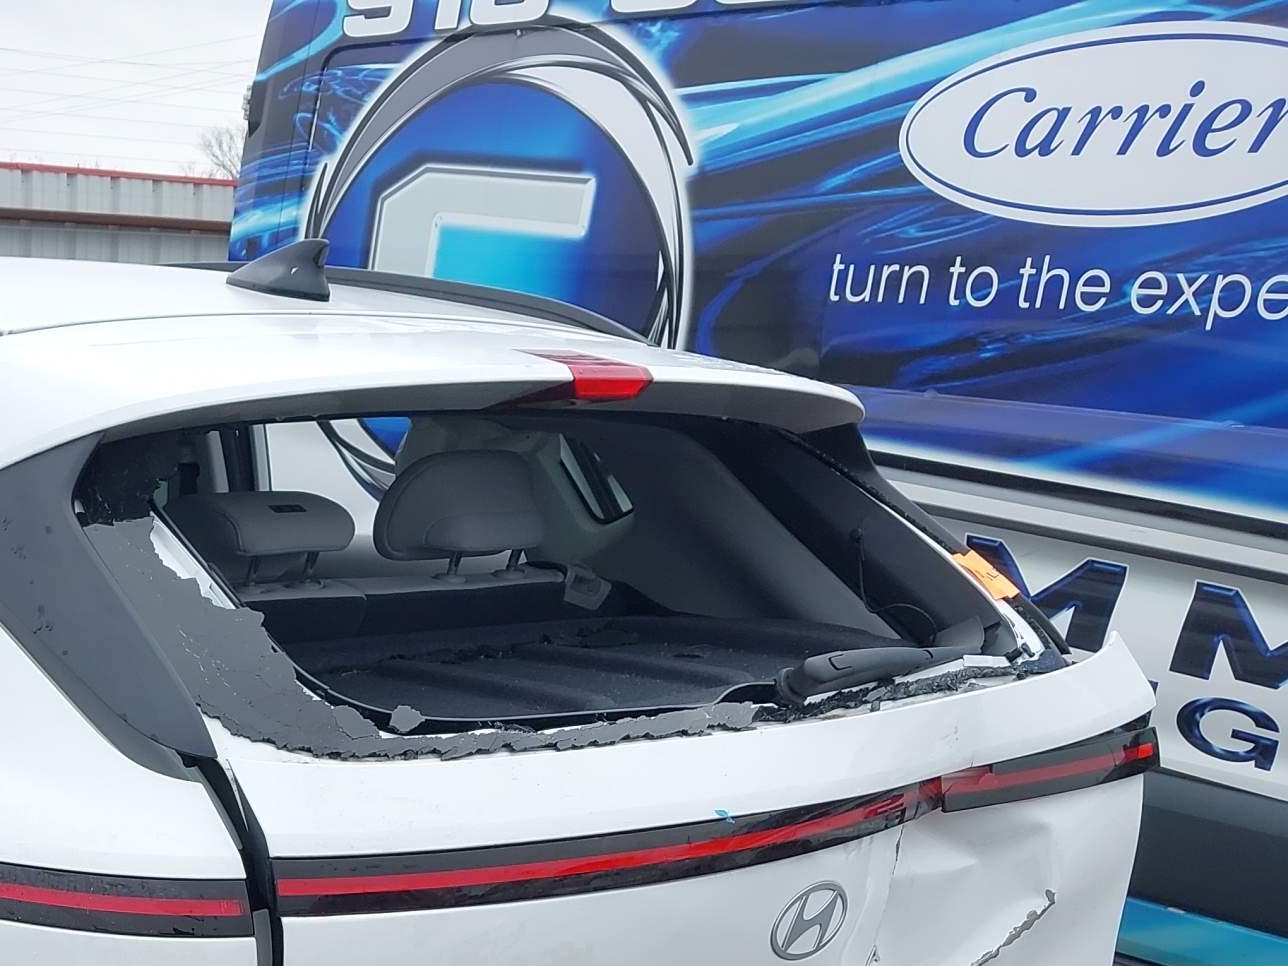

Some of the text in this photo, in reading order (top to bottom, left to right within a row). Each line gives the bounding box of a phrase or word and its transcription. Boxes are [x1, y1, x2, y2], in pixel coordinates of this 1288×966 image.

[963, 80, 1288, 159] Carrier
[828, 254, 930, 305] turn
[948, 255, 999, 309] to
[1017, 255, 1111, 312] the
